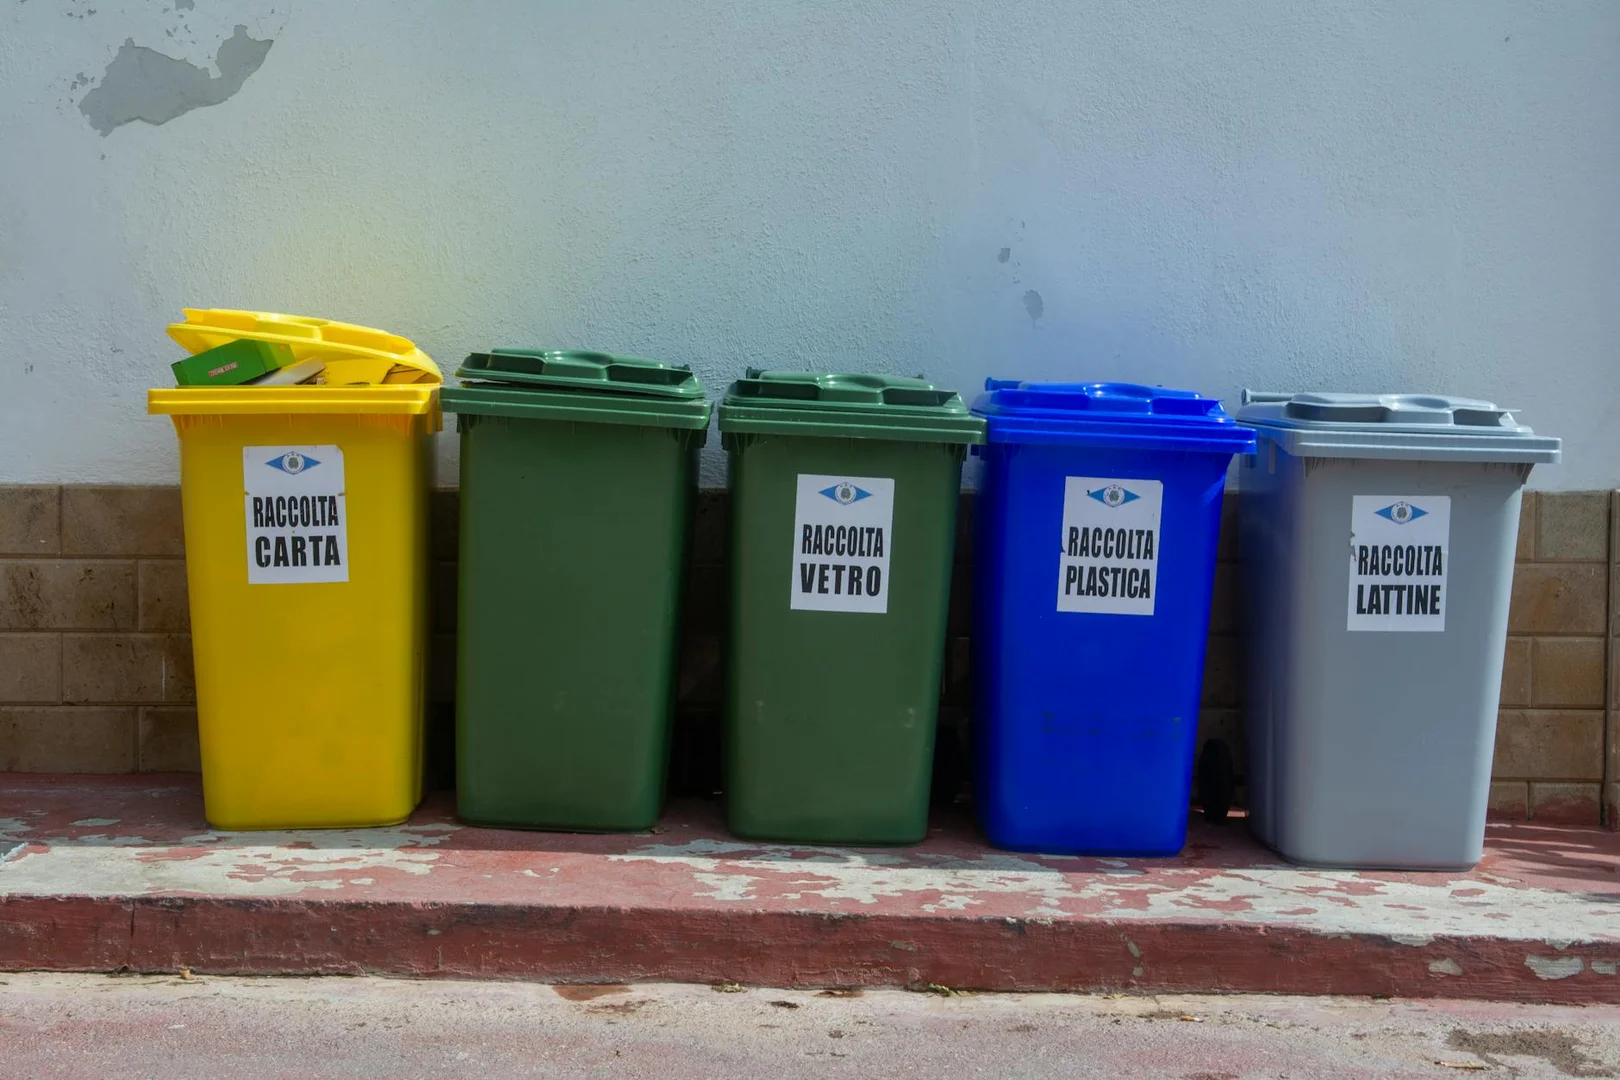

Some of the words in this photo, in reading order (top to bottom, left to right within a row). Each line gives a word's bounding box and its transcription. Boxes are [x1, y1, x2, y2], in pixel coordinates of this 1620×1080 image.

[252, 495, 339, 528] RACCOLTA
[255, 535, 341, 568] CARTA
[802, 524, 884, 558] RACCOLTA
[1067, 526, 1153, 560] RACCOLTA
[1358, 544, 1442, 576] RACCOLTA
[801, 563, 882, 597] VETRO
[1065, 565, 1151, 599] PLASTICA
[1356, 584, 1441, 615] LATTINE
